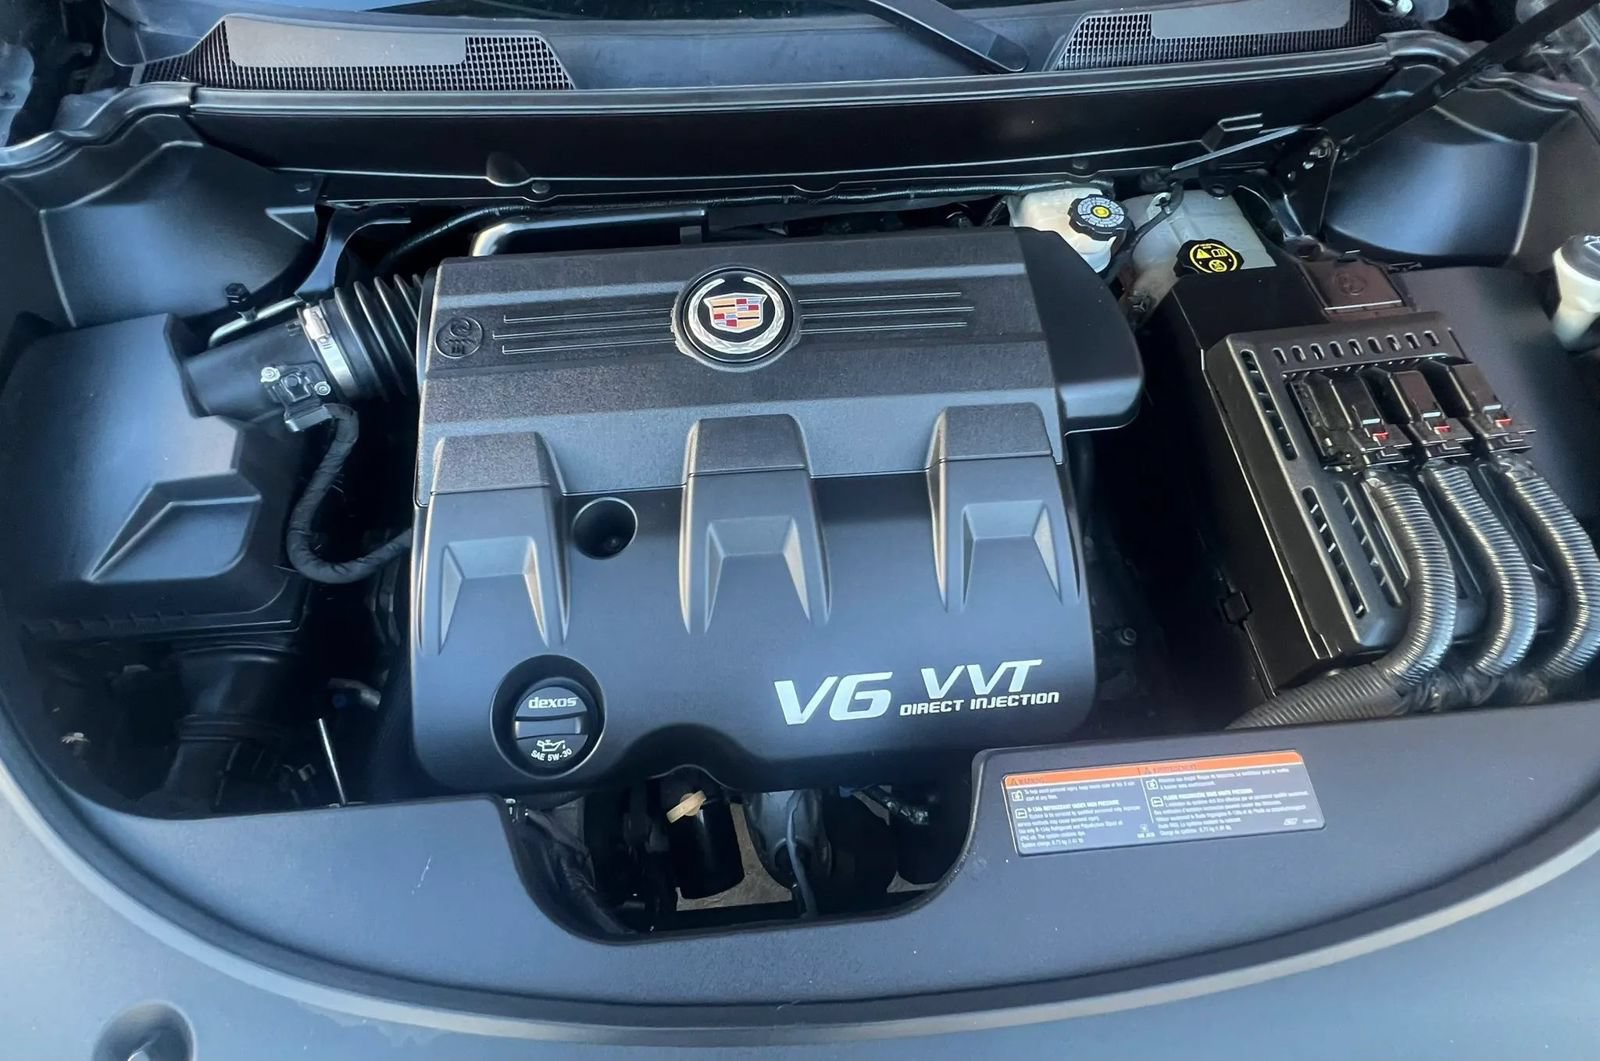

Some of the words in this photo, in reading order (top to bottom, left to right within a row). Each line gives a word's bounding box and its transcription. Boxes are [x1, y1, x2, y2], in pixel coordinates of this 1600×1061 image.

[774, 671, 893, 725] V6
[920, 659, 1043, 699] VVT
[528, 696, 578, 709] dexos
[899, 699, 965, 716] DIRECT
[970, 692, 1060, 710] INJECTION
[530, 749, 545, 761] SAE
[547, 748, 572, 762] 5W-30
